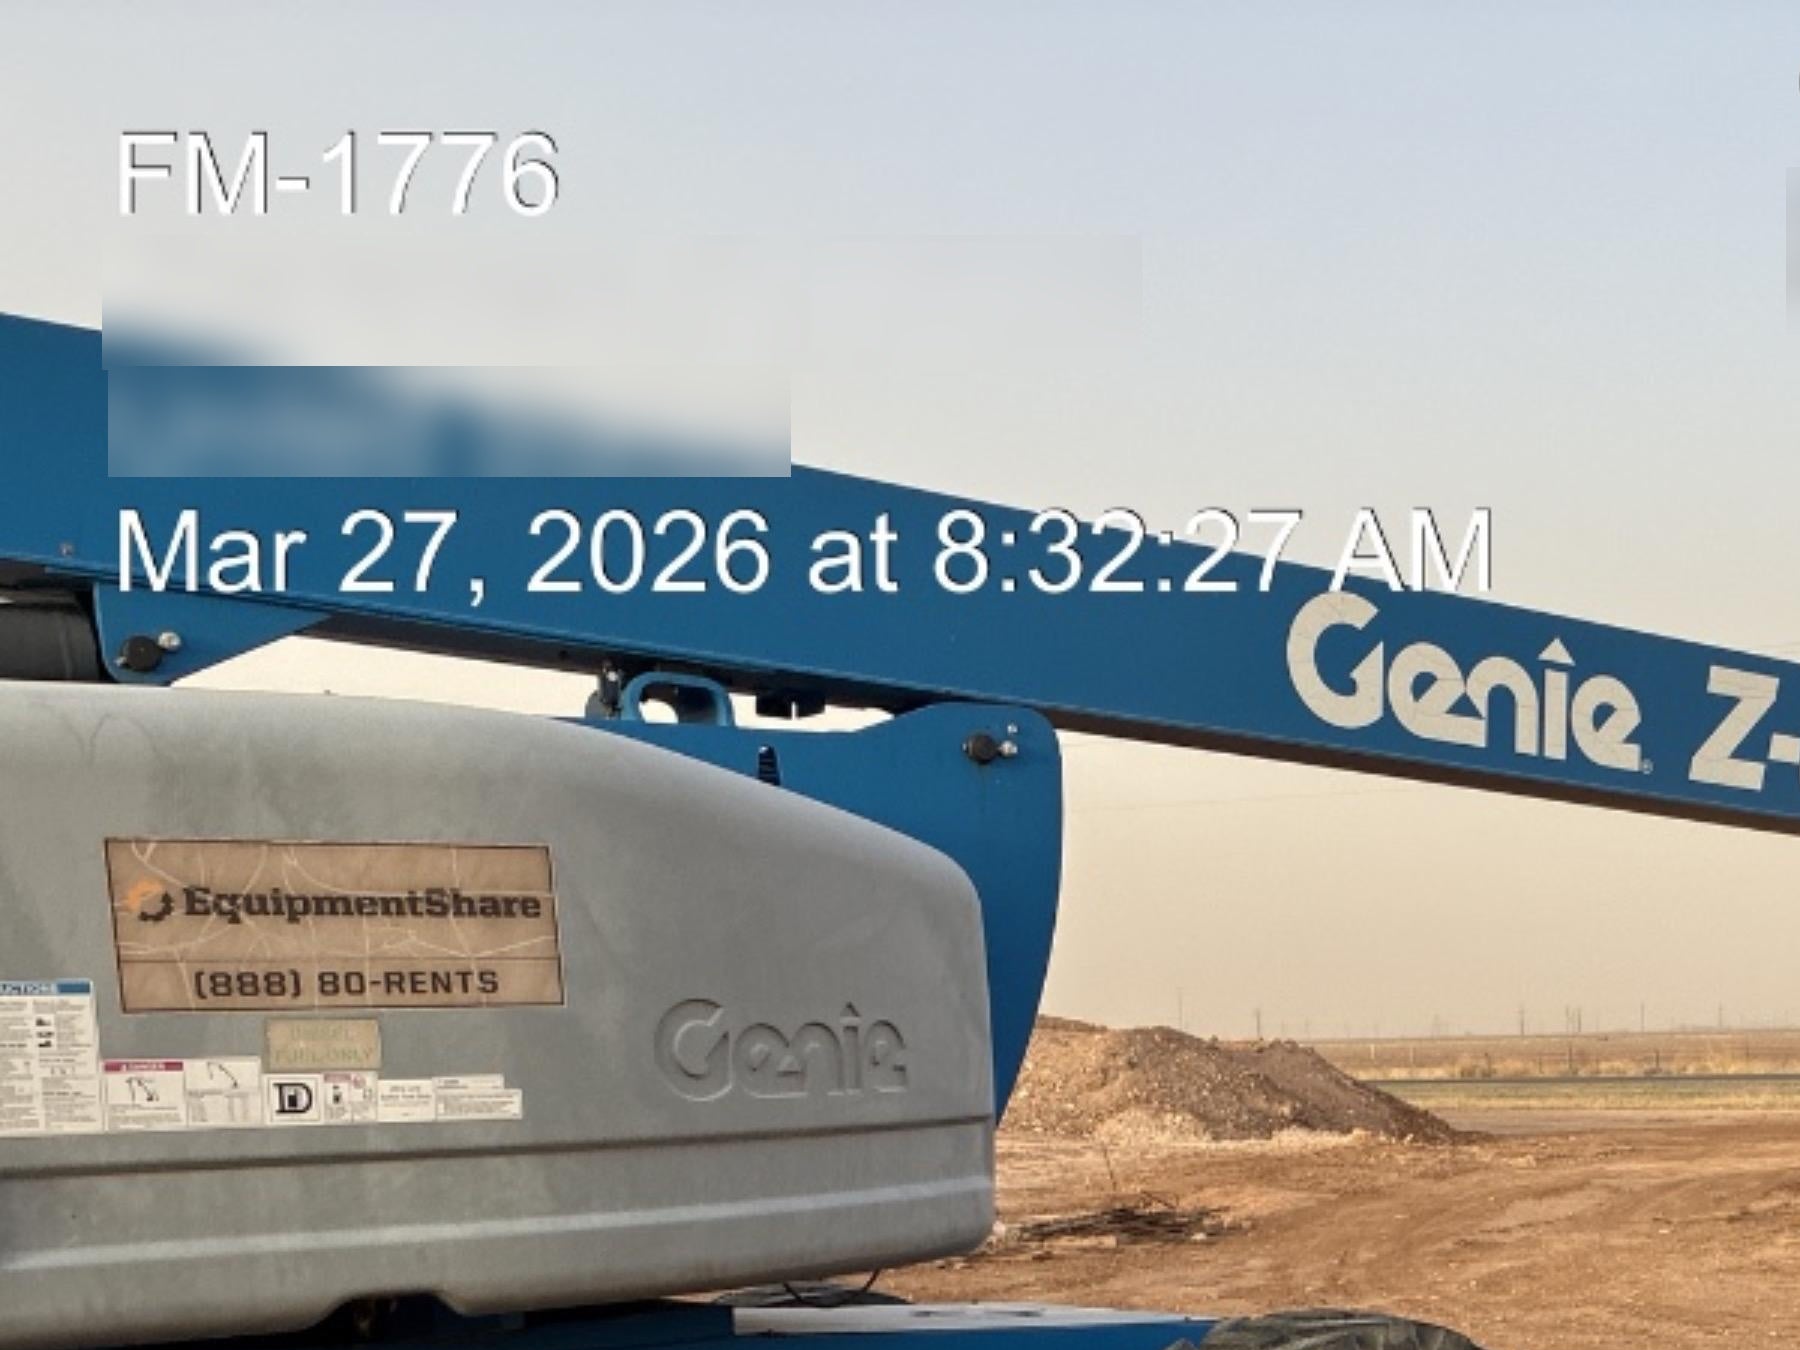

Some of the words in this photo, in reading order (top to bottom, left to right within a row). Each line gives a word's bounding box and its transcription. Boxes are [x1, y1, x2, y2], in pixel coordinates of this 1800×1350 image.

[1286, 589, 1645, 773] Genie
[183, 886, 542, 924] EquipmentShare
[194, 969, 301, 998] (888)
[318, 969, 499, 995] 80-RENTS
[653, 998, 909, 1101] Genie
